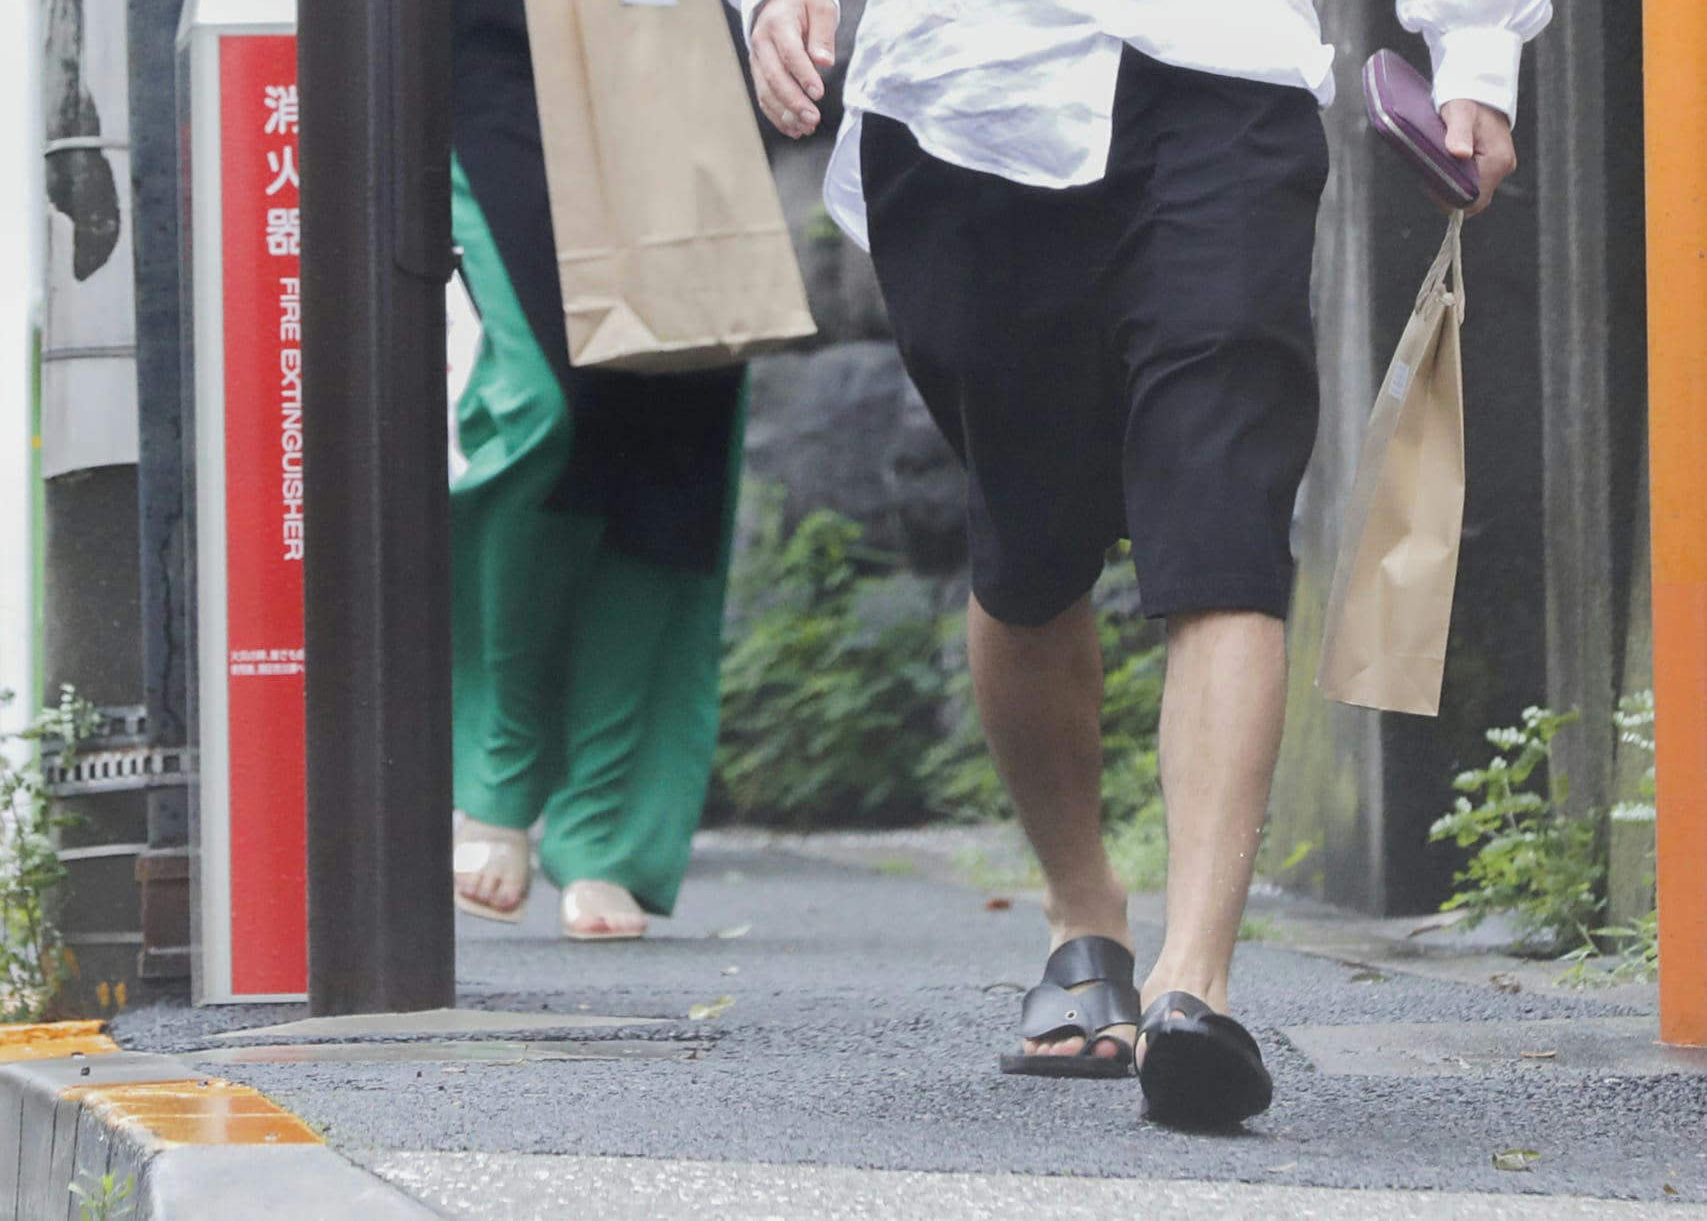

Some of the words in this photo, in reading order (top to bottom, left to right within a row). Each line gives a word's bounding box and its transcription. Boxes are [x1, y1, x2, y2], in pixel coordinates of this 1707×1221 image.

[264, 84, 300, 256] 消火器
[279, 277, 301, 341] FIRE
[280, 348, 304, 561] EXTINGUISHER
